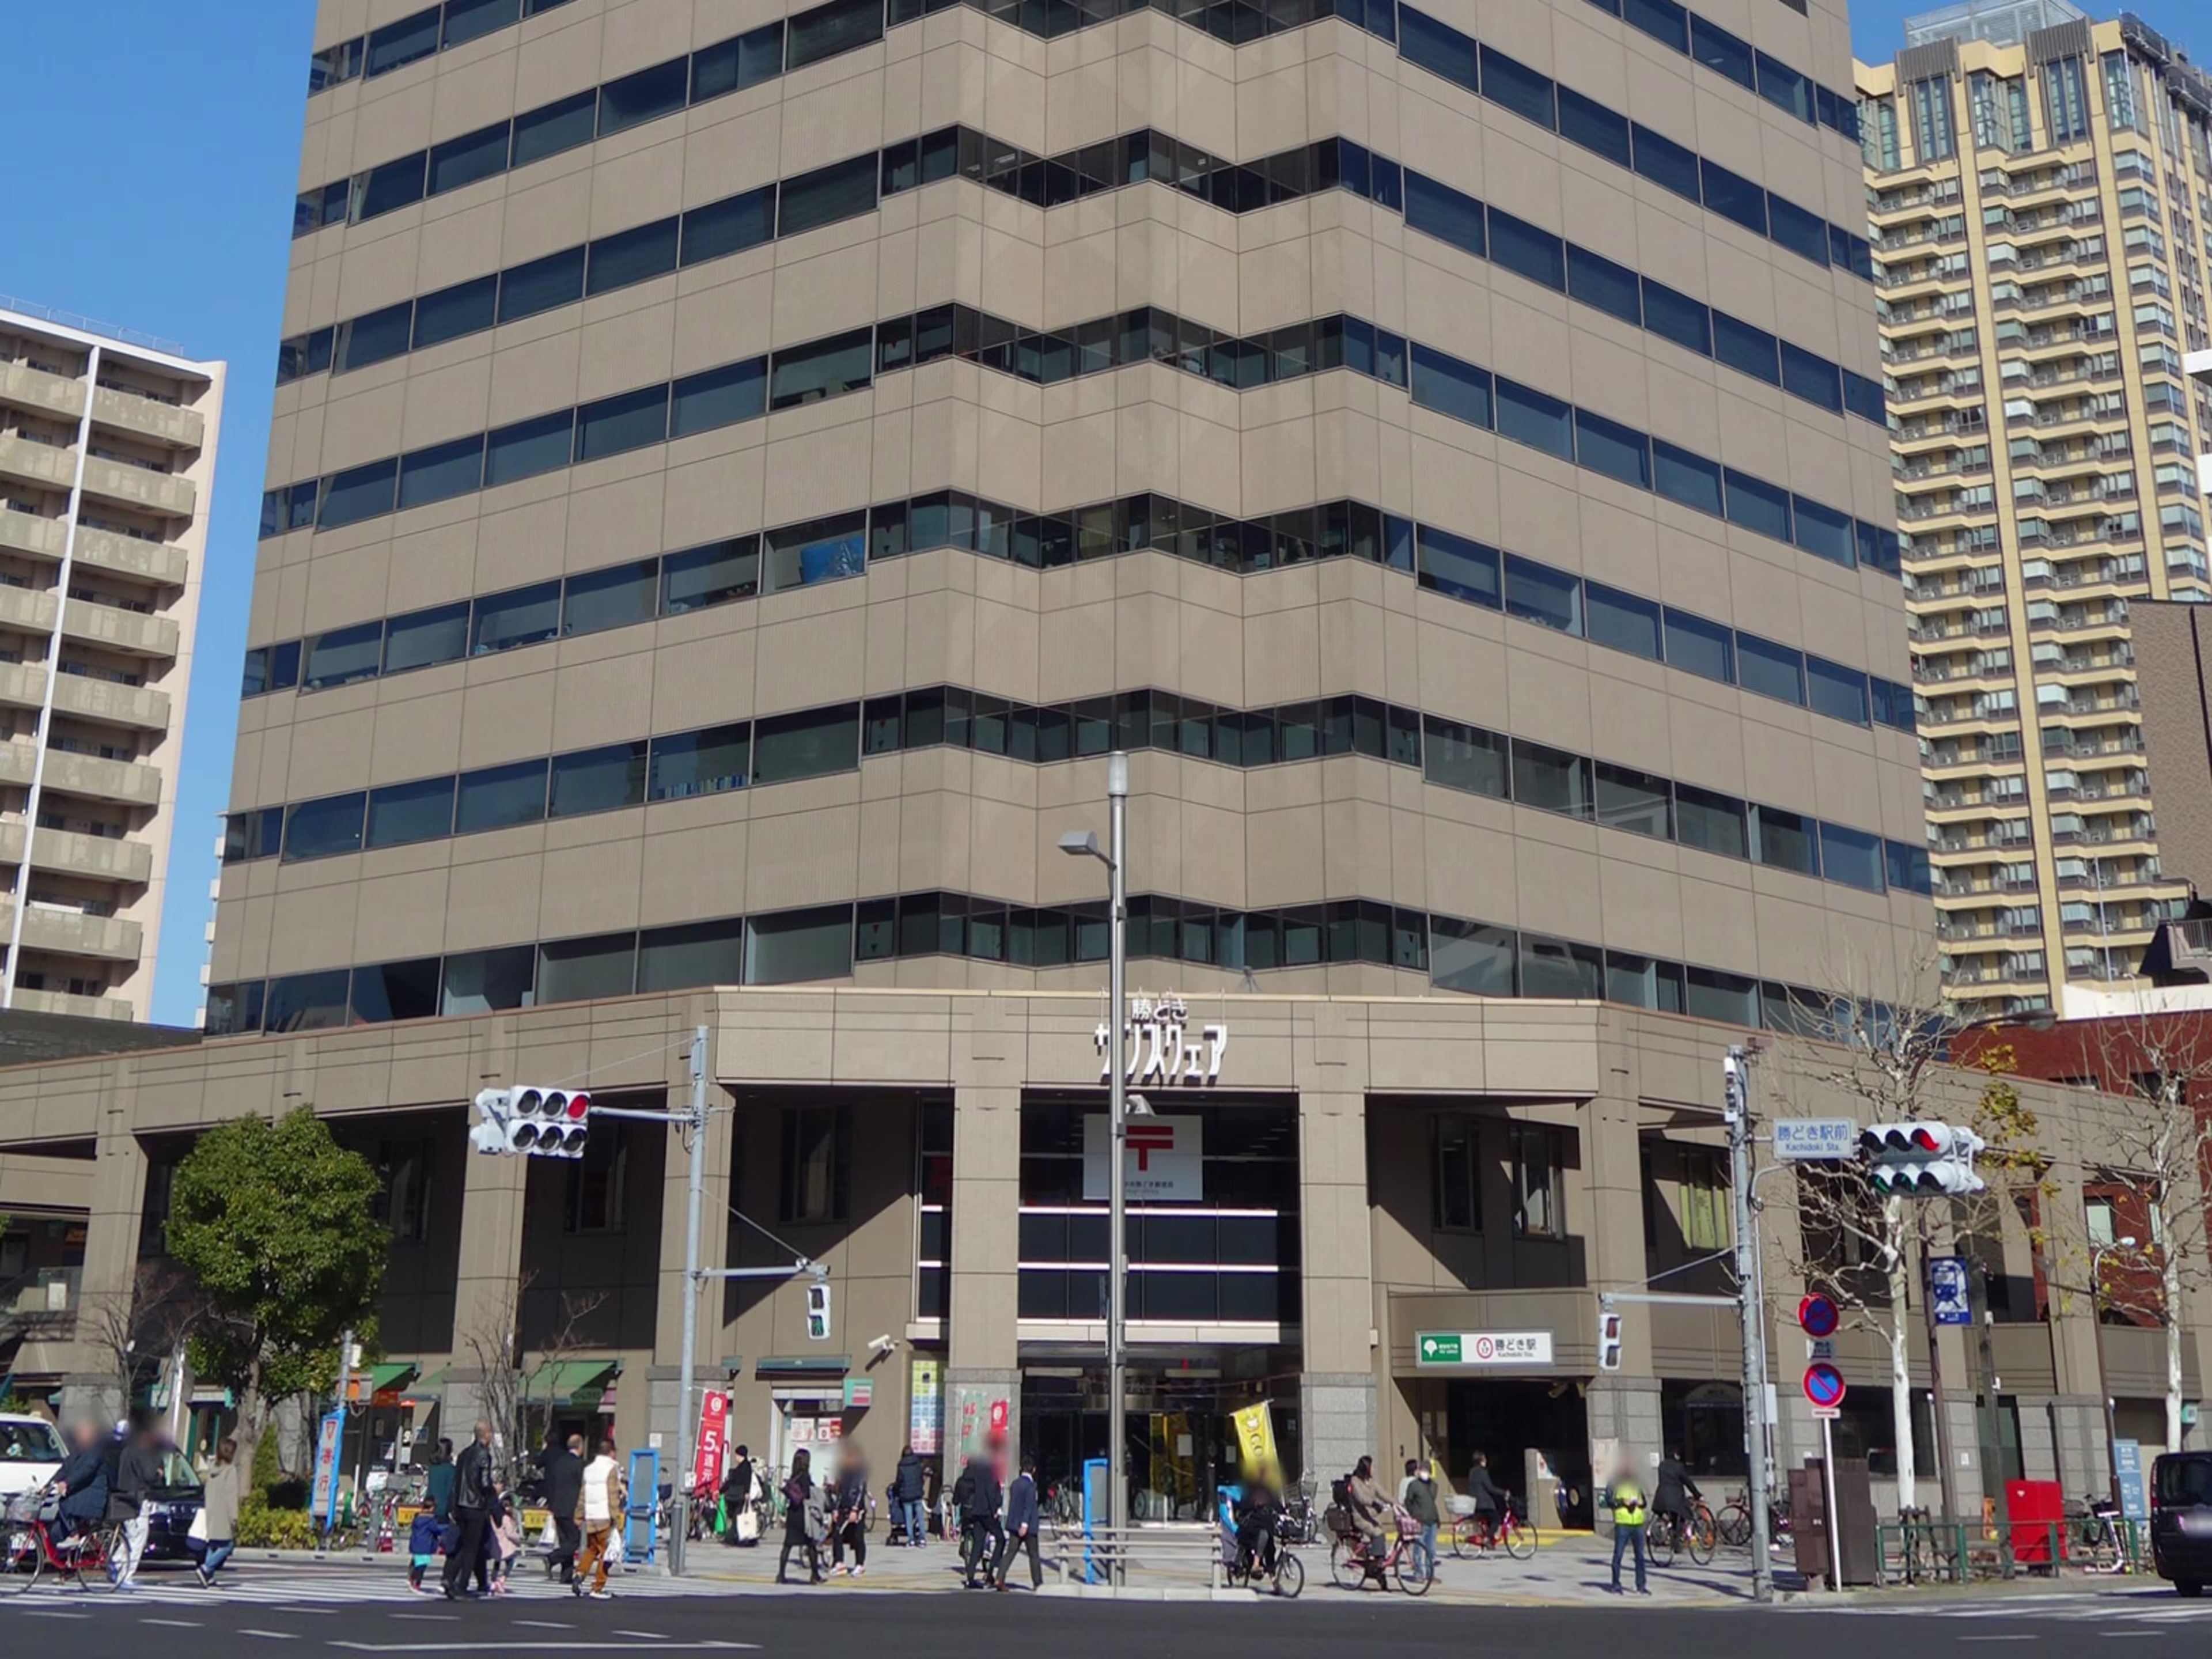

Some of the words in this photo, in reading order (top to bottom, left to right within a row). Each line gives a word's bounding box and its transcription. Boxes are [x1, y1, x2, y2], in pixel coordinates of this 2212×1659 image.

[1132, 998, 1188, 1020] 勝どき
[1778, 1124, 1848, 1141] 勝どき駅前
[1786, 1142, 1823, 1152] Kachidoki
[1826, 1142, 1841, 1152] Sta.
[1495, 1339, 1536, 1351] 勝どき駅
